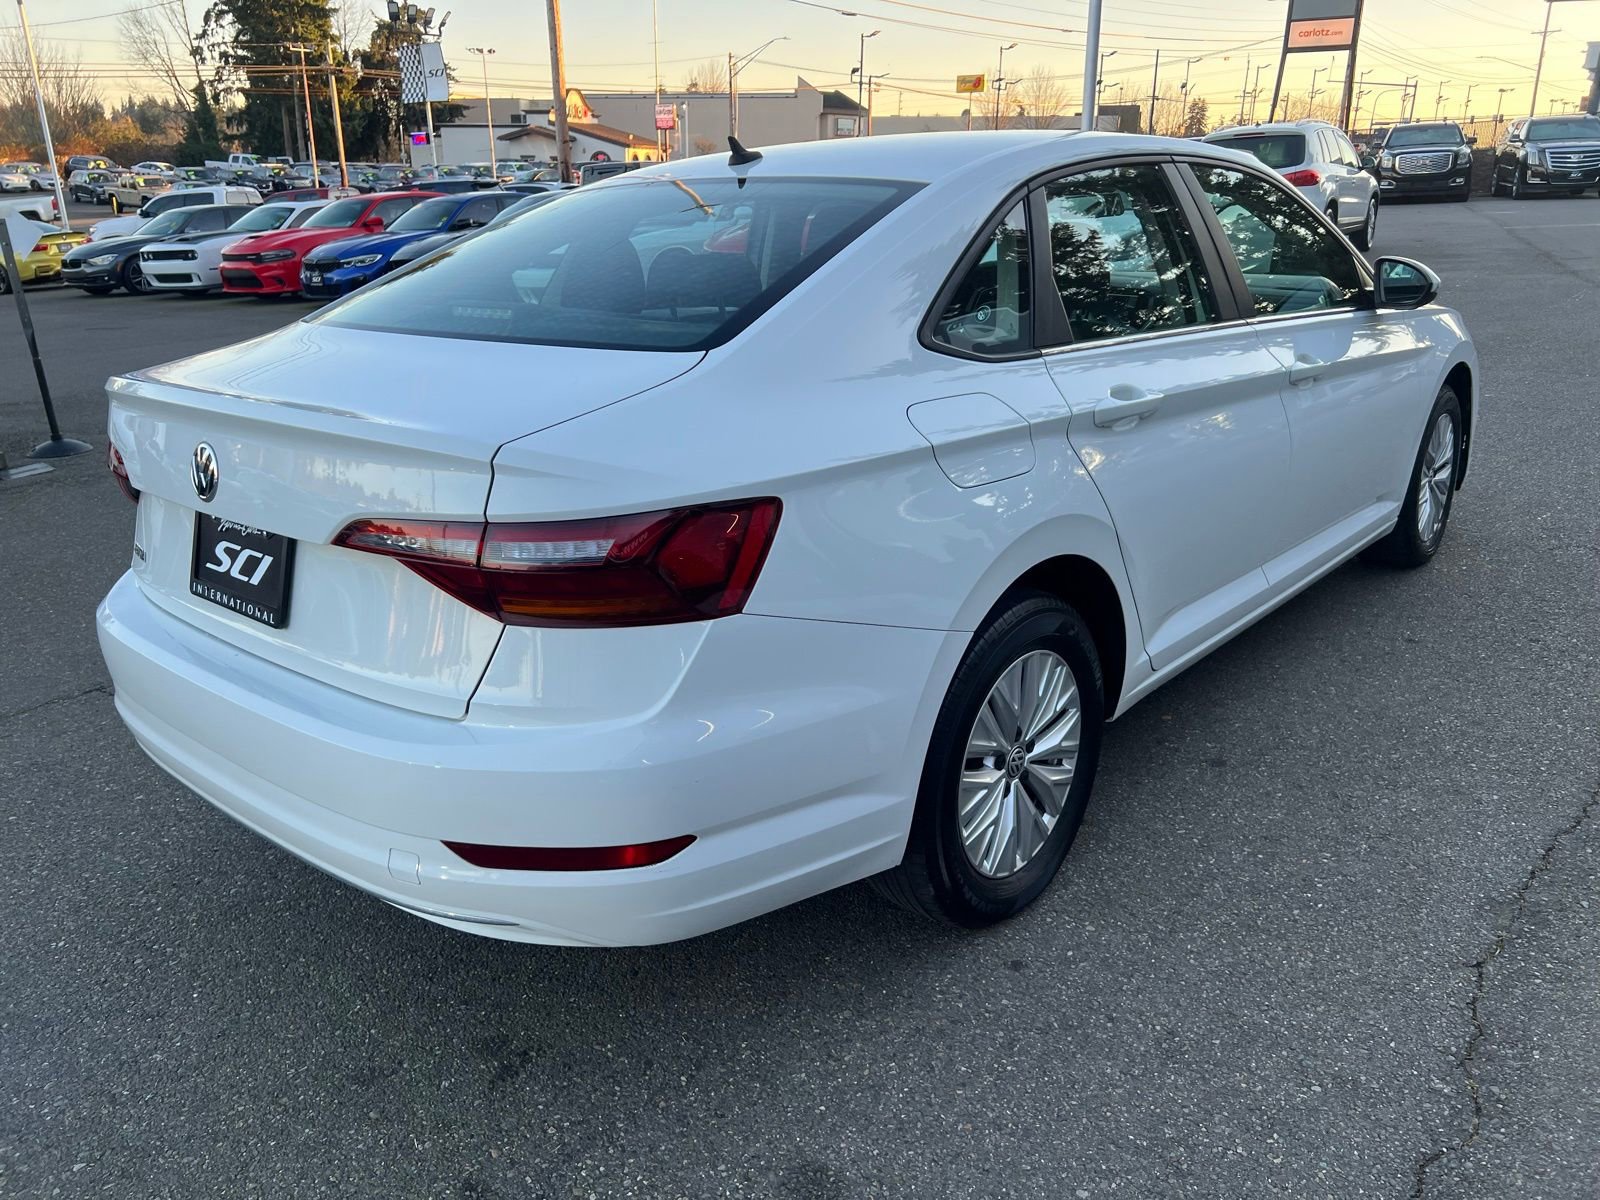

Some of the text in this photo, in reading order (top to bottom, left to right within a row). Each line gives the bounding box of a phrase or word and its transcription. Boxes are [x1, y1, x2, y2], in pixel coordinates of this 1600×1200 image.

[1298, 28, 1343, 37] carlotz.com
[427, 69, 444, 78] SCI
[205, 540, 274, 586] SCI
[192, 582, 275, 625] INTERNATIONAL
